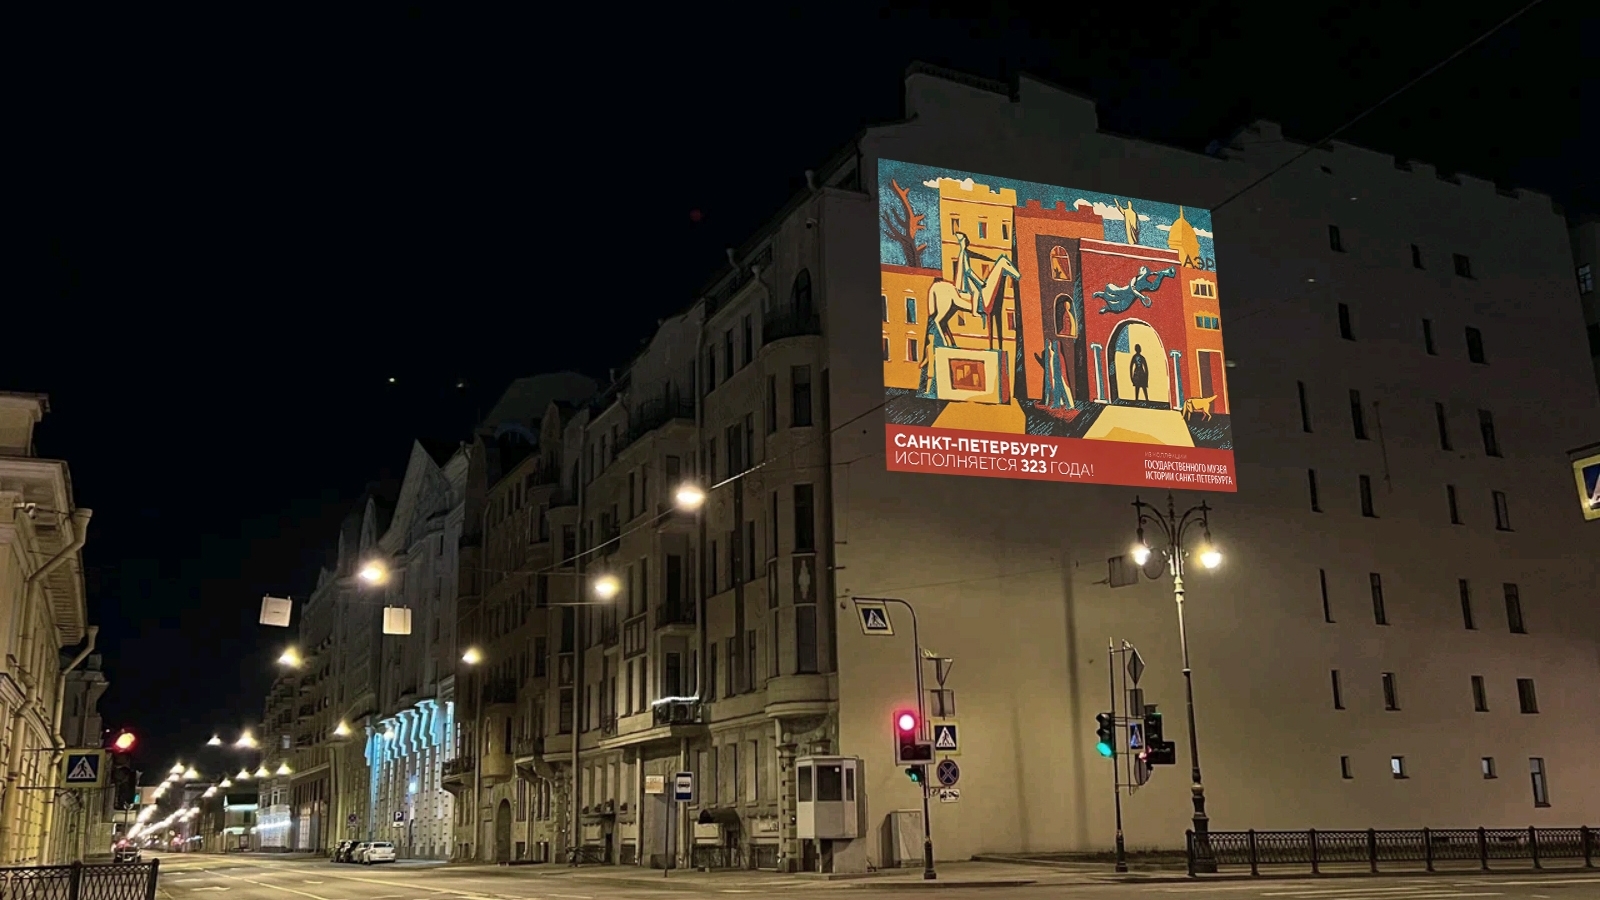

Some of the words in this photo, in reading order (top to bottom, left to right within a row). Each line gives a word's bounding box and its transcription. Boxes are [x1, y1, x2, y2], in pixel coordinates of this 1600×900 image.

[894, 433, 1058, 457] САНКТ-ПЕТЕРБУРГУ
[895, 450, 1018, 472] ИСПОЛНЯЕТСЯ
[1020, 459, 1047, 474] 323
[1050, 461, 1095, 478] ГОДА!
[1144, 459, 1206, 473] ГОСУДАРСТВЕННОГО
[1207, 464, 1228, 475] МУЗЕЯ
[1145, 470, 1174, 481] ИСТОРИИ
[1175, 472, 1233, 485] САНКТ-ПЕТЕРБУРГА
